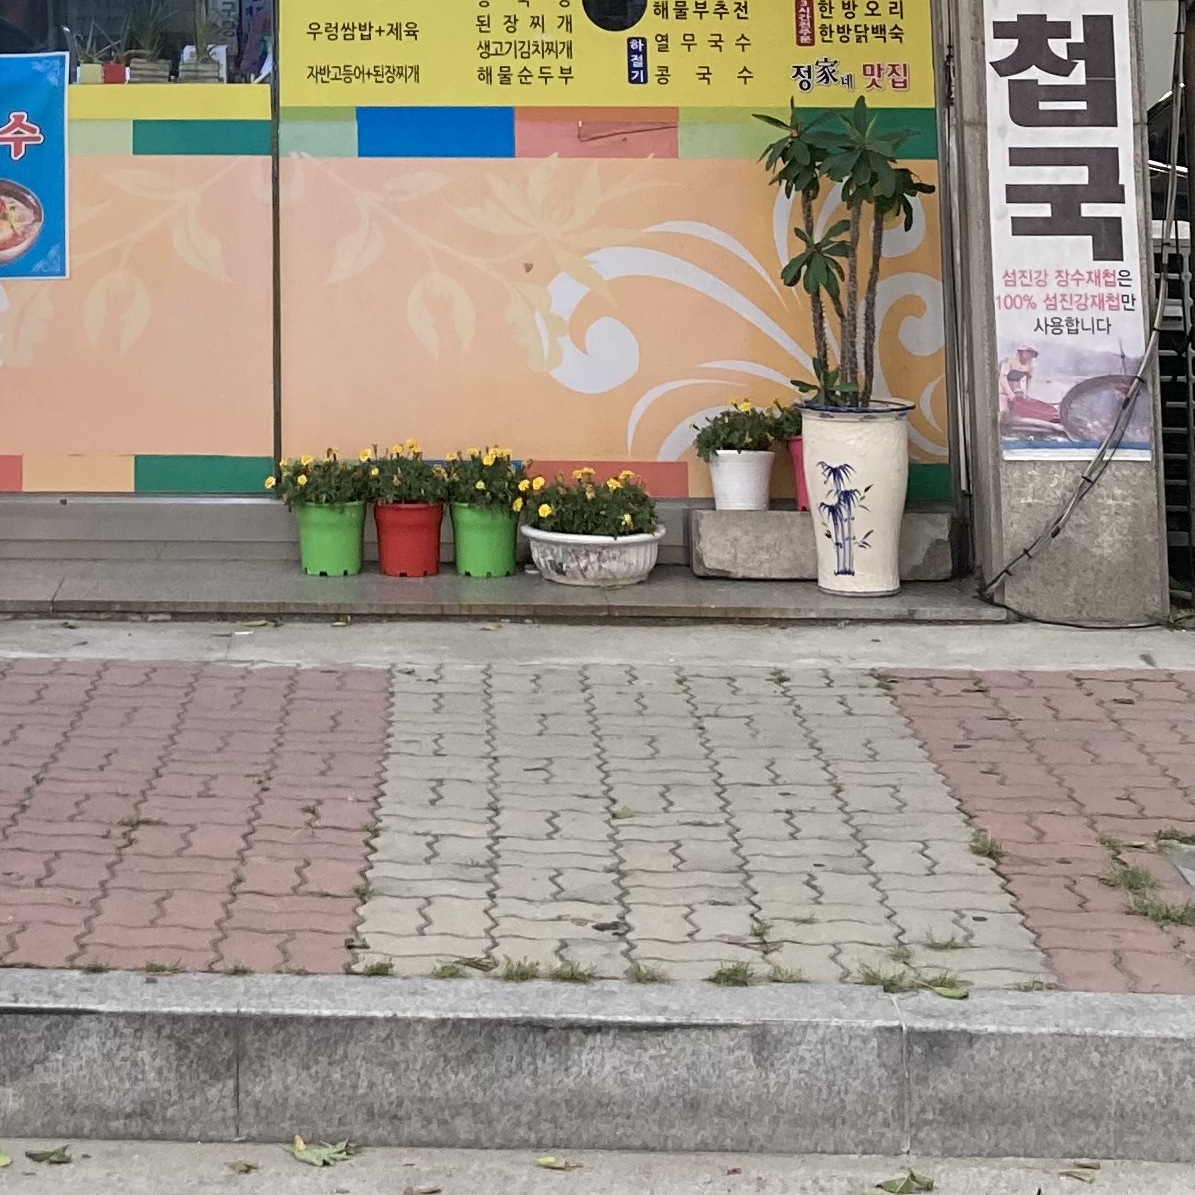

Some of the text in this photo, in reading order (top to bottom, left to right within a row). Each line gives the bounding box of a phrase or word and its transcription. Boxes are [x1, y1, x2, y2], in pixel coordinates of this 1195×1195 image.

[305, 21, 421, 42] 우렁쌈밥+제육
[819, 23, 906, 45] 한방닭백숙
[476, 40, 574, 60] 생고기김치찌개
[629, 38, 645, 83] 하절기
[306, 63, 421, 85] 자반고등어+된장찌개
[862, 62, 911, 91] 맛집
[1001, 268, 1134, 289] 섬진강 장수재첩은
[995, 291, 1137, 312] 100% 섬진강재첩만
[1033, 316, 1112, 337] 사용합니다
